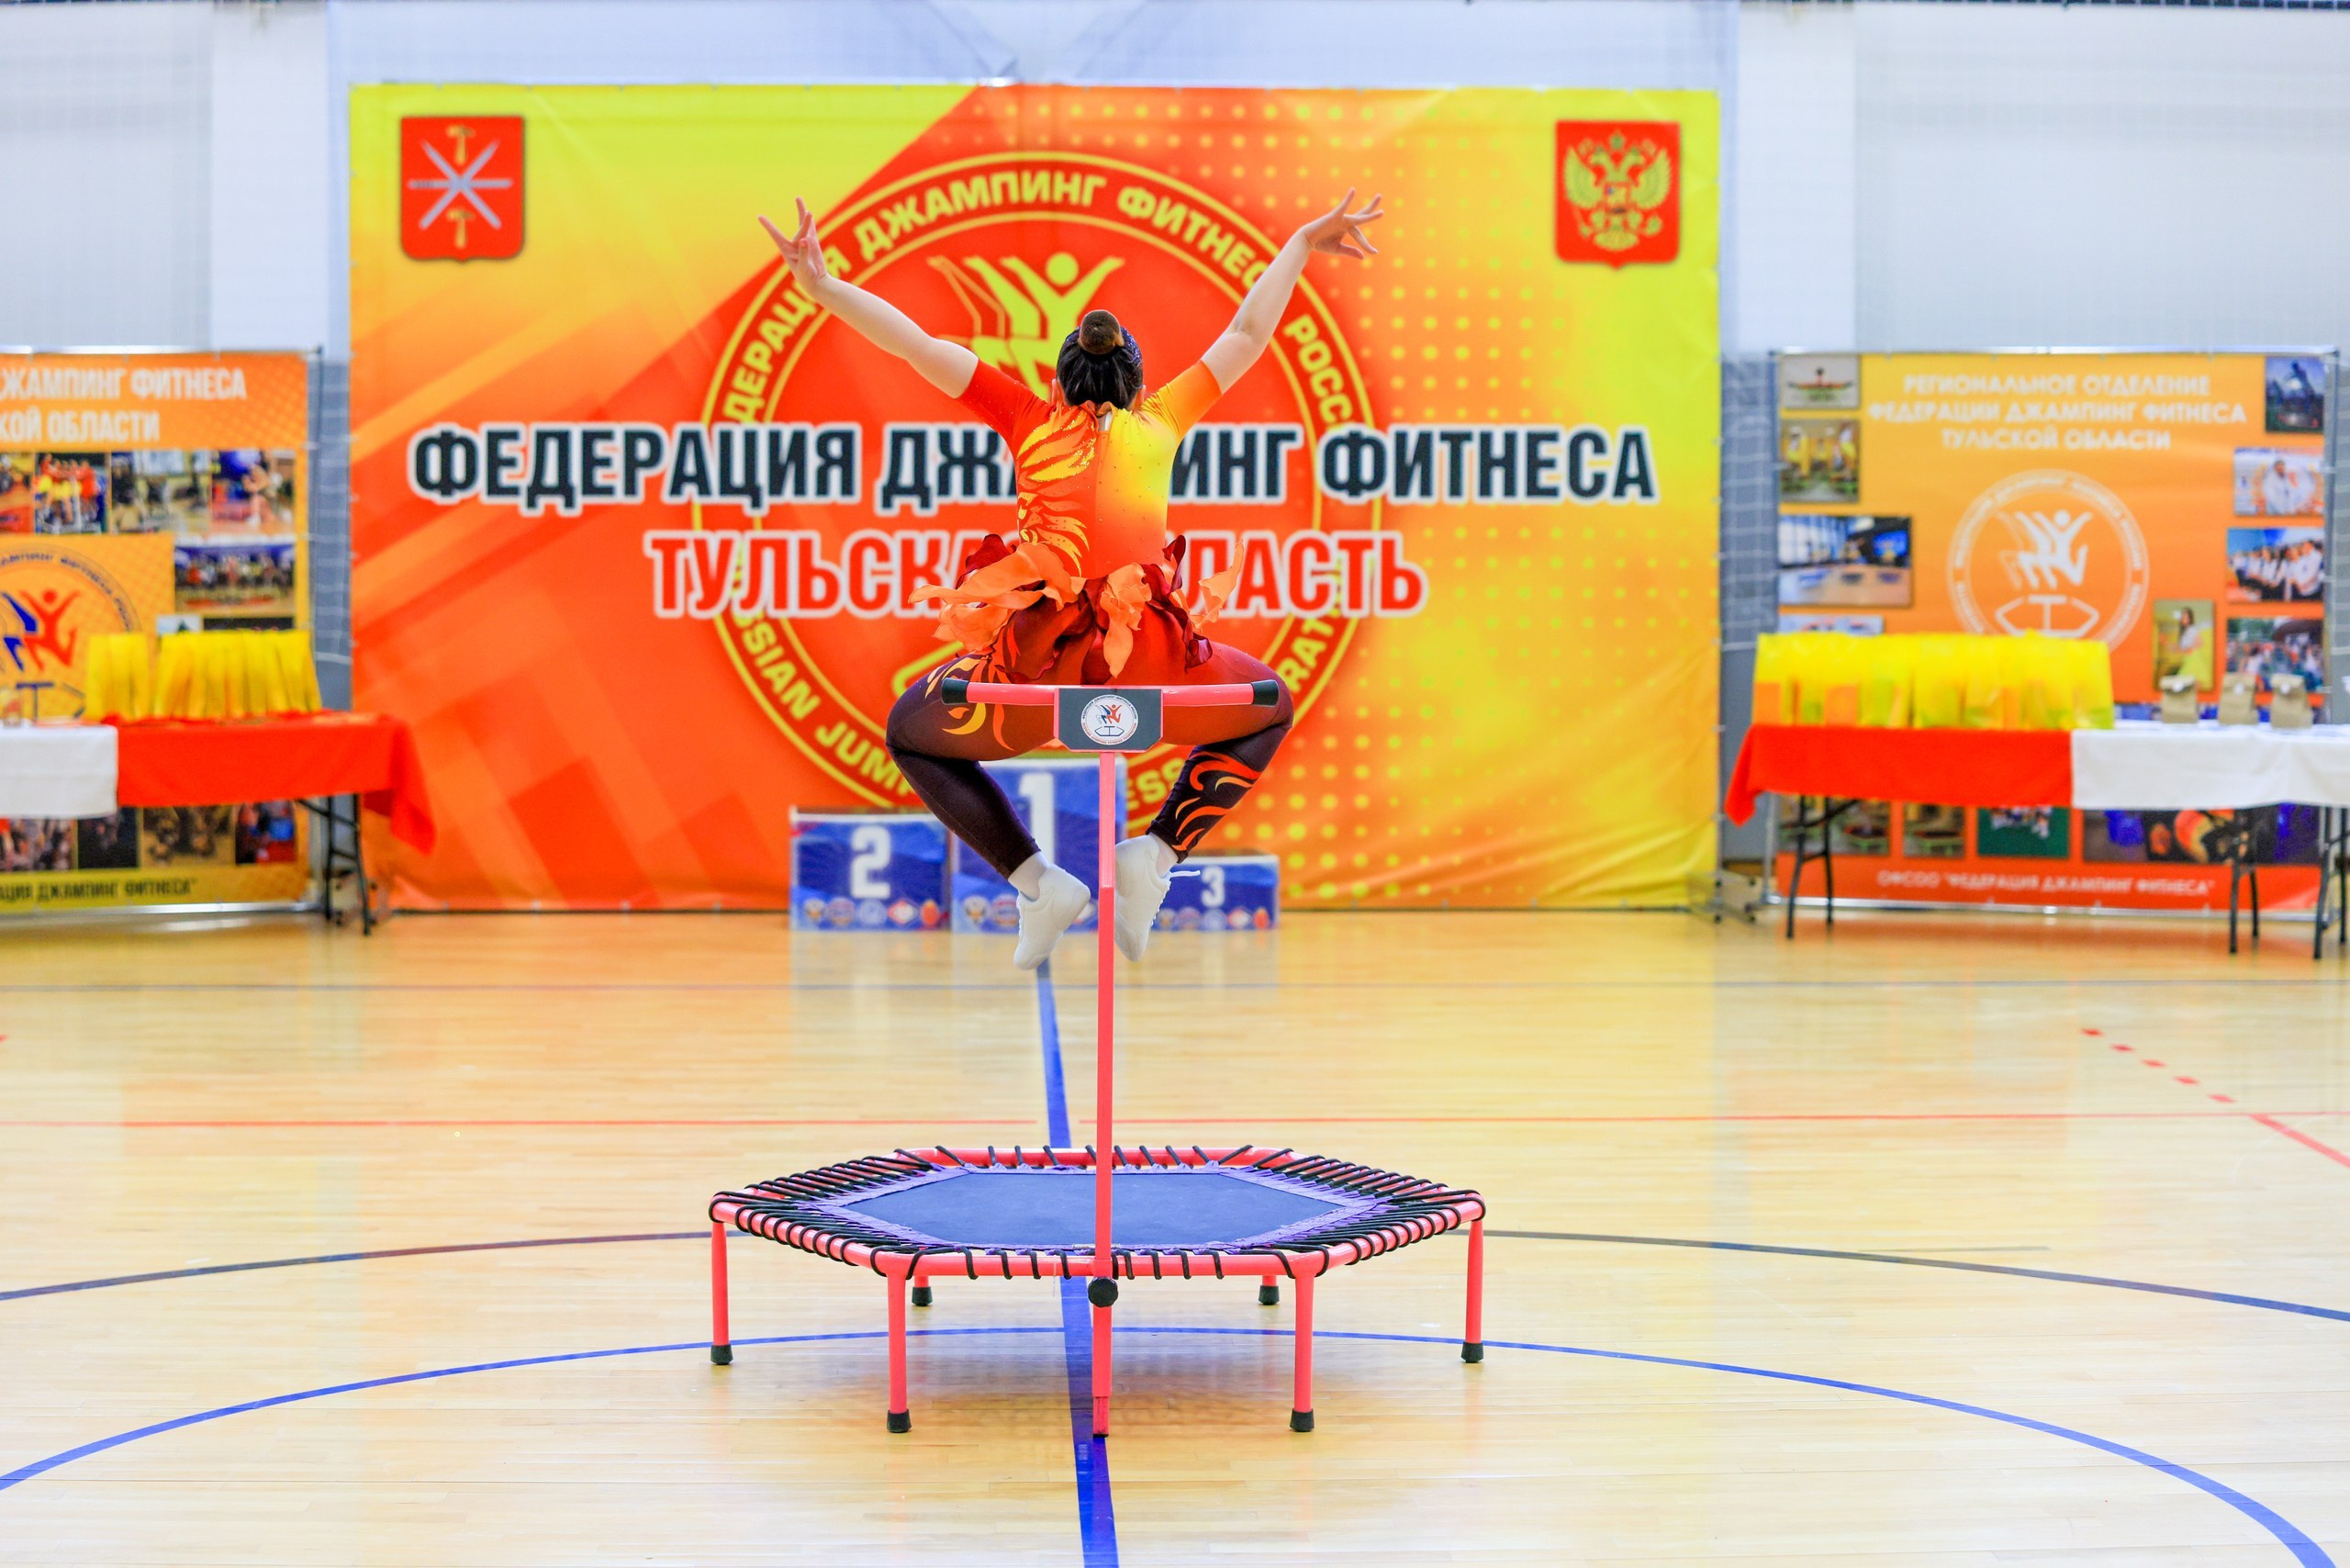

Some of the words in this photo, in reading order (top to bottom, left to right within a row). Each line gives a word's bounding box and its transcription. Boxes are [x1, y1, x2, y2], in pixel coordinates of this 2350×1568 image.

[722, 246, 851, 425] ДЕРАЦЯ
[854, 170, 1107, 263] ДЖАМПИНГ
[1117, 186, 1270, 290] ФИТНЕС
[1282, 314, 1353, 425] РОСС
[130, 367, 247, 400] ФИТНЕСА
[1904, 374, 2076, 395] РЕГИОНАЛЬНОЕ
[2083, 374, 2210, 396] ОТДЕЛЕНИЕ
[48, 410, 161, 443] ОБЛАСТИ
[1867, 401, 2000, 422] ФЕДЕРАЦИИ
[2004, 401, 2135, 423] ДЖАМПИНГ
[2142, 403, 2247, 424] ФИТНЕСА
[1942, 425, 2059, 449] ТУЛЬСКОЙ
[2064, 429, 2171, 450] ОБЛАСТИ
[412, 426, 857, 513] ФЕДЕРАЦИЯ
[879, 426, 1300, 512] ДЖИНГ
[1320, 426, 1658, 501] ФИТНЕСА
[648, 534, 1019, 615] ТУЛЬСК
[1179, 534, 1426, 615] ЛАСТЬ
[1019, 772, 1055, 865] 1
[850, 826, 891, 900] 2
[1201, 867, 1225, 908] 3
